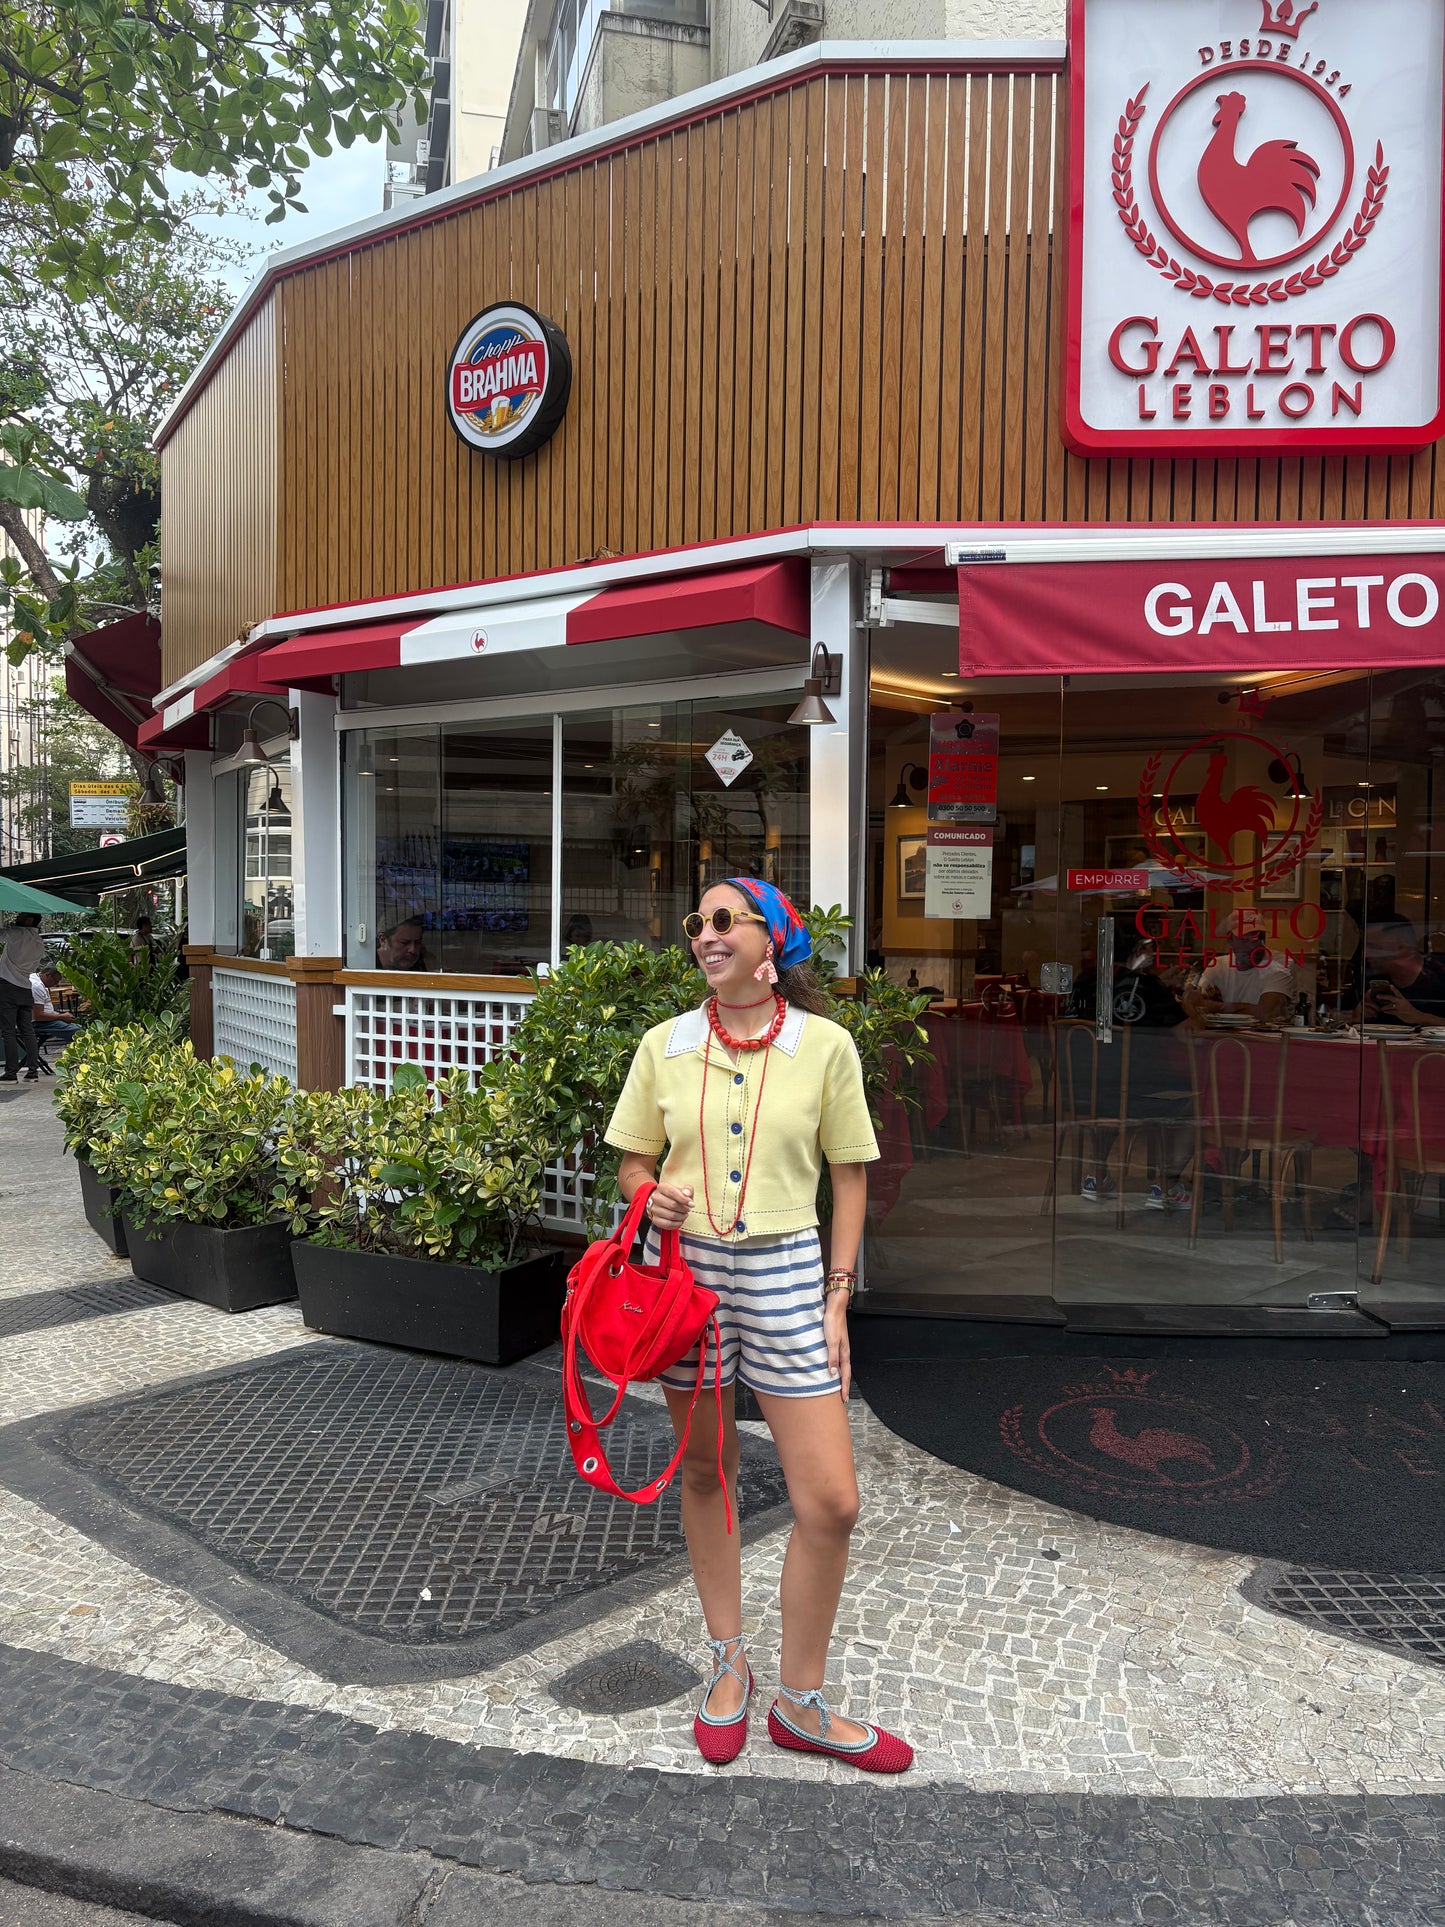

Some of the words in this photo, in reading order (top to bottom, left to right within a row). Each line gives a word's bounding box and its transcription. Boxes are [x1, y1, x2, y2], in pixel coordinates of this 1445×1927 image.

[1198, 38, 1292, 65] DESDE
[1299, 52, 1353, 98] 1954
[470, 334, 526, 365] Chopp
[1108, 313, 1396, 377] GALETO
[460, 352, 538, 403] BRAHMA
[1138, 381, 1362, 419] LEBLON
[1144, 572, 1440, 636] GALETO
[712, 753, 728, 761] 24H
[933, 758, 993, 773] Alarme
[934, 832, 986, 840] COMUNICADO
[1075, 874, 1141, 885] EMPURRE
[1135, 901, 1327, 940] GALETO
[1155, 946, 1305, 969] LEBLON
